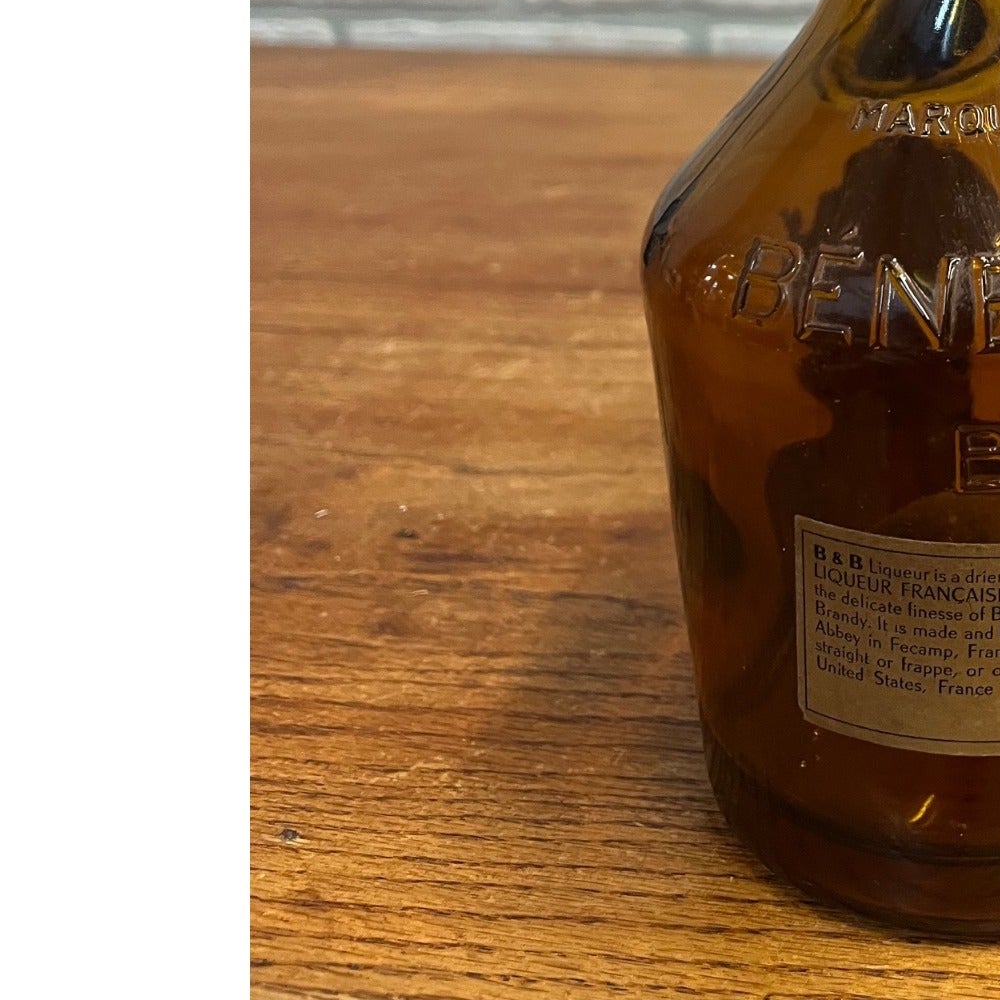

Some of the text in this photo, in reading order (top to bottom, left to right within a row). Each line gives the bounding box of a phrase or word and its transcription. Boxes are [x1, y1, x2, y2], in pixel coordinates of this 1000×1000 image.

[814, 544, 827, 561] B
[832, 552, 842, 565] &
[850, 554, 863, 570] B
[869, 558, 930, 581] Liqueur
[934, 569, 946, 583] is
[951, 573, 960, 583] a
[814, 563, 892, 595] LIQUEUR
[814, 584, 836, 600] the
[842, 591, 902, 615] delicate
[908, 602, 963, 621] finesse
[969, 606, 986, 621] of
[815, 600, 872, 629] Brandy.
[878, 616, 888, 632] It
[895, 624, 907, 634] is
[914, 625, 958, 639] made
[964, 628, 994, 640] and
[815, 620, 860, 646] Abbey
[869, 634, 881, 648] in
[891, 637, 958, 660] Fecamp,
[815, 640, 869, 665] straight
[877, 658, 894, 669] or
[901, 657, 957, 679] frappe,
[966, 667, 984, 677] or
[816, 655, 864, 681] United
[874, 671, 926, 694] States,
[939, 680, 993, 695] France
